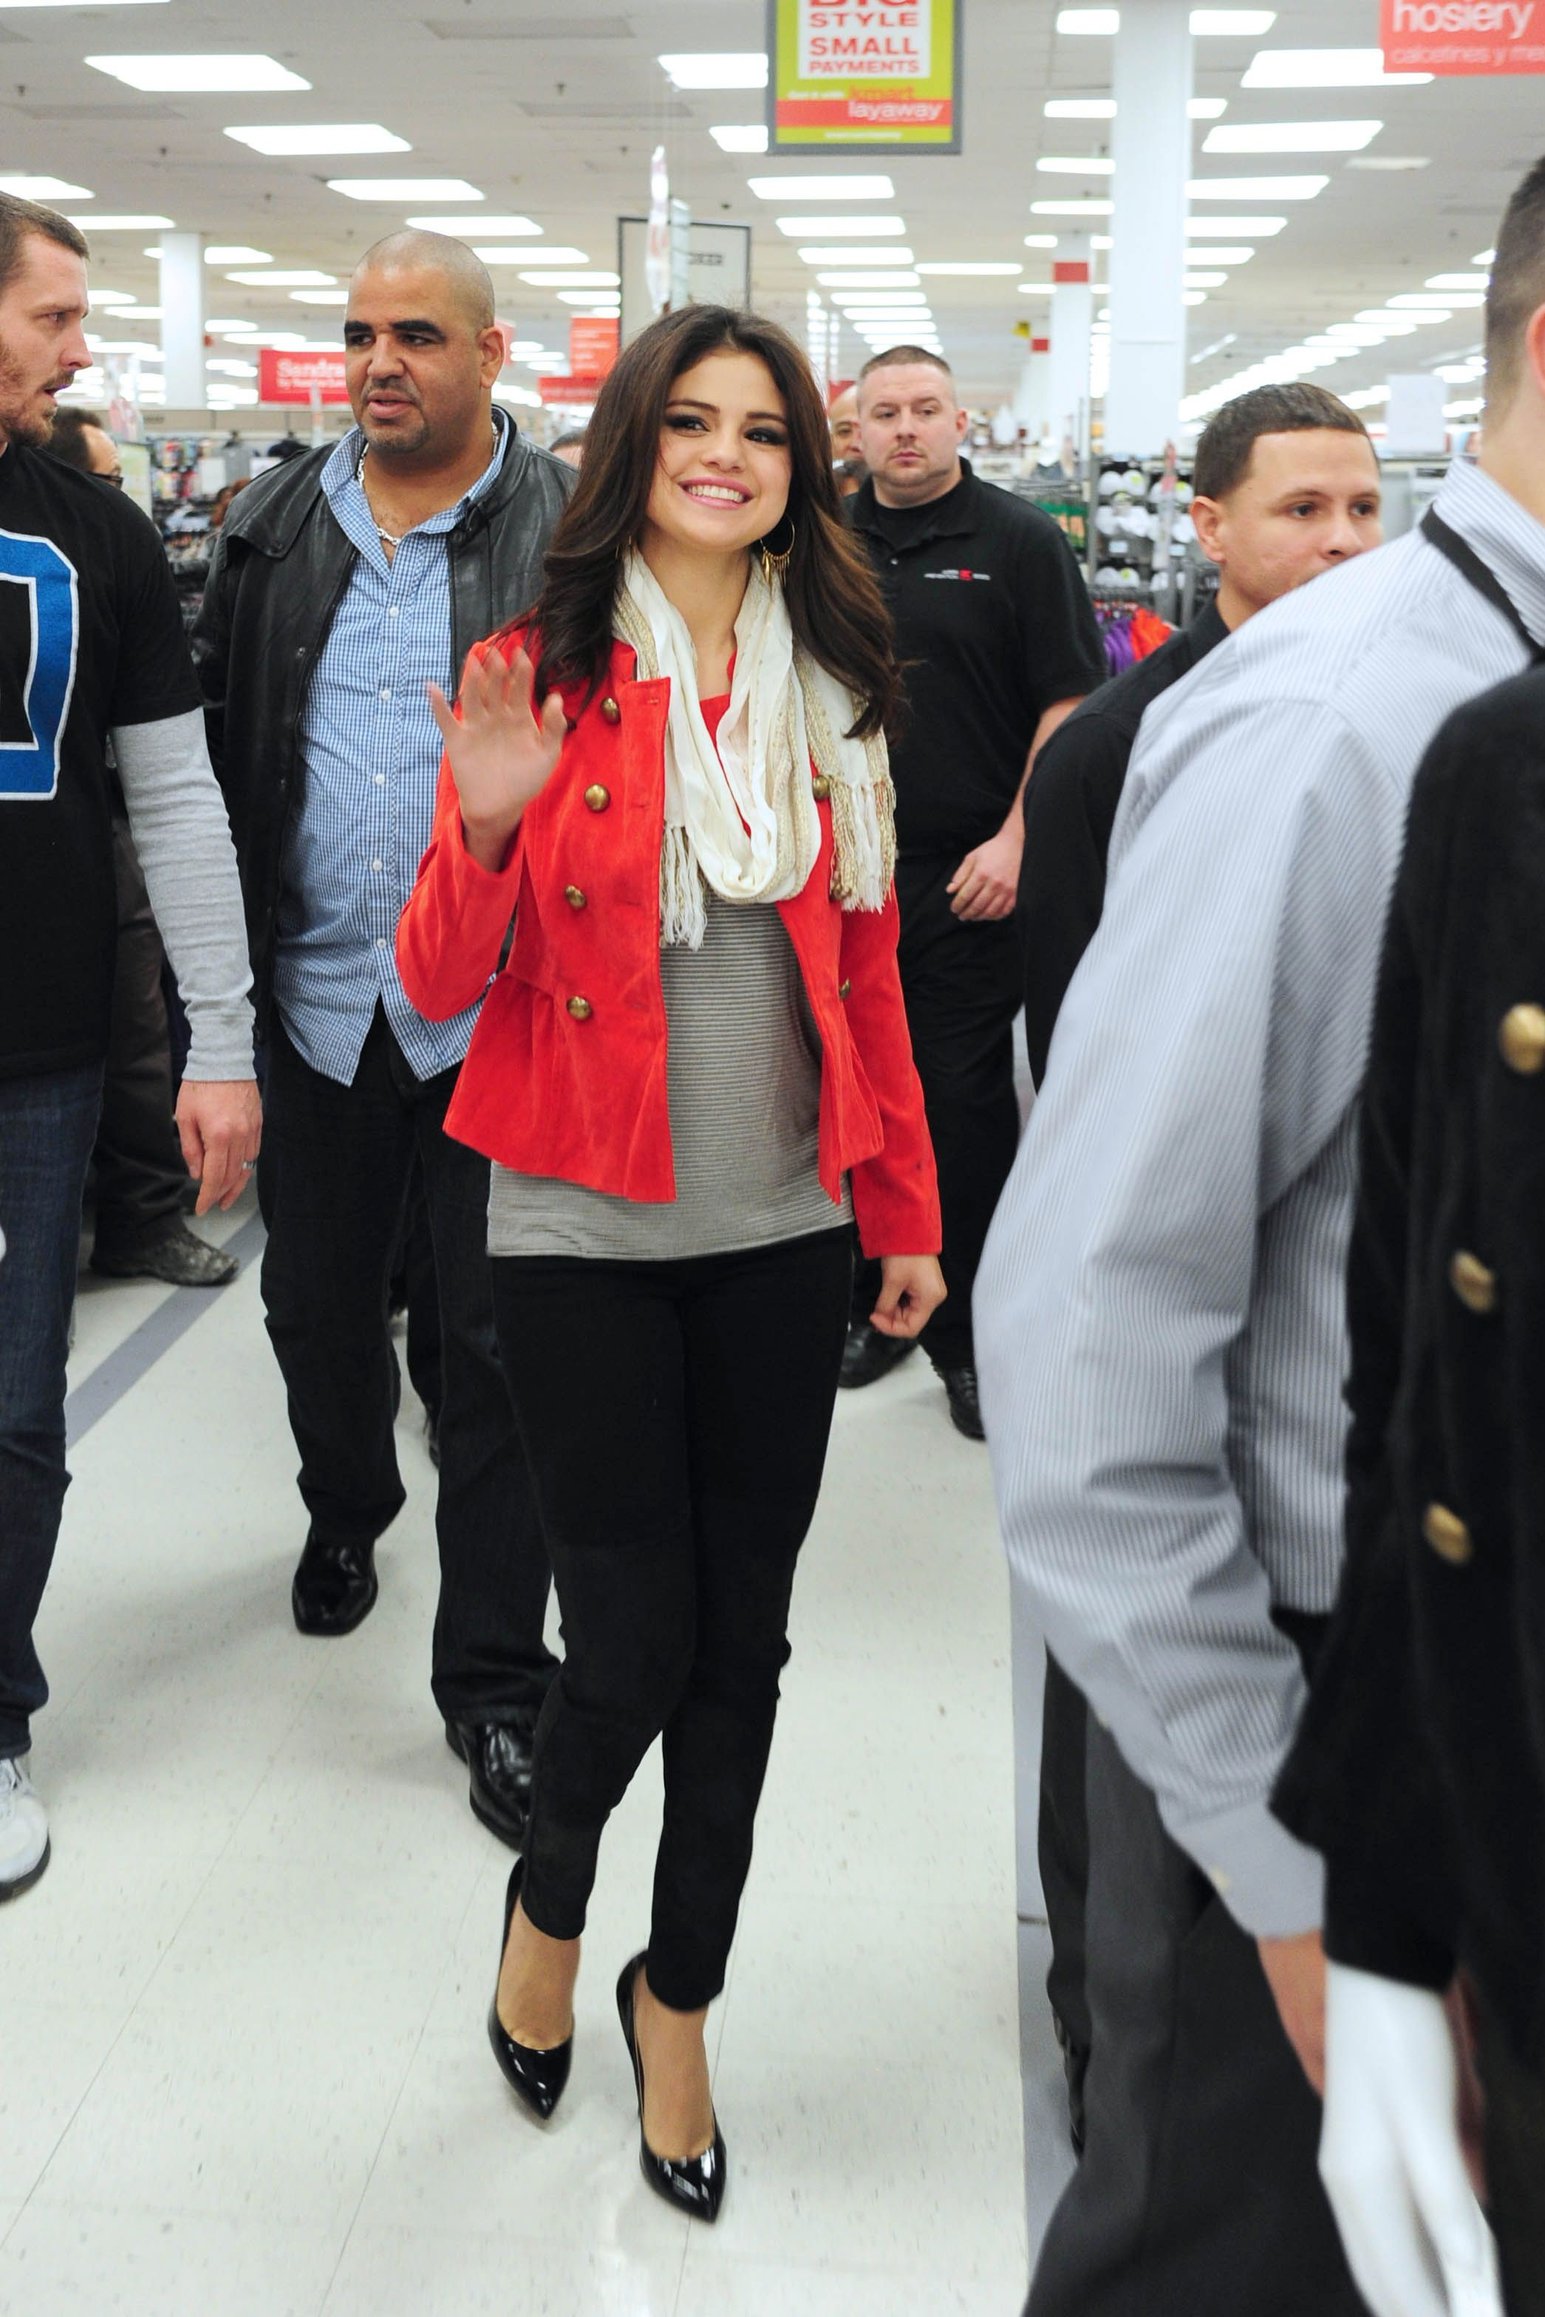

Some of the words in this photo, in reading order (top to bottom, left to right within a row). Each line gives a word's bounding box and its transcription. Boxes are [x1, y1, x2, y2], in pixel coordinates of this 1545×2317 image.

[809, 12, 919, 28] STYLE
[1394, 0, 1534, 39] hosiery
[809, 37, 919, 56] SMALL
[809, 60, 919, 74] PAYMENTS
[848, 100, 943, 121] layaway
